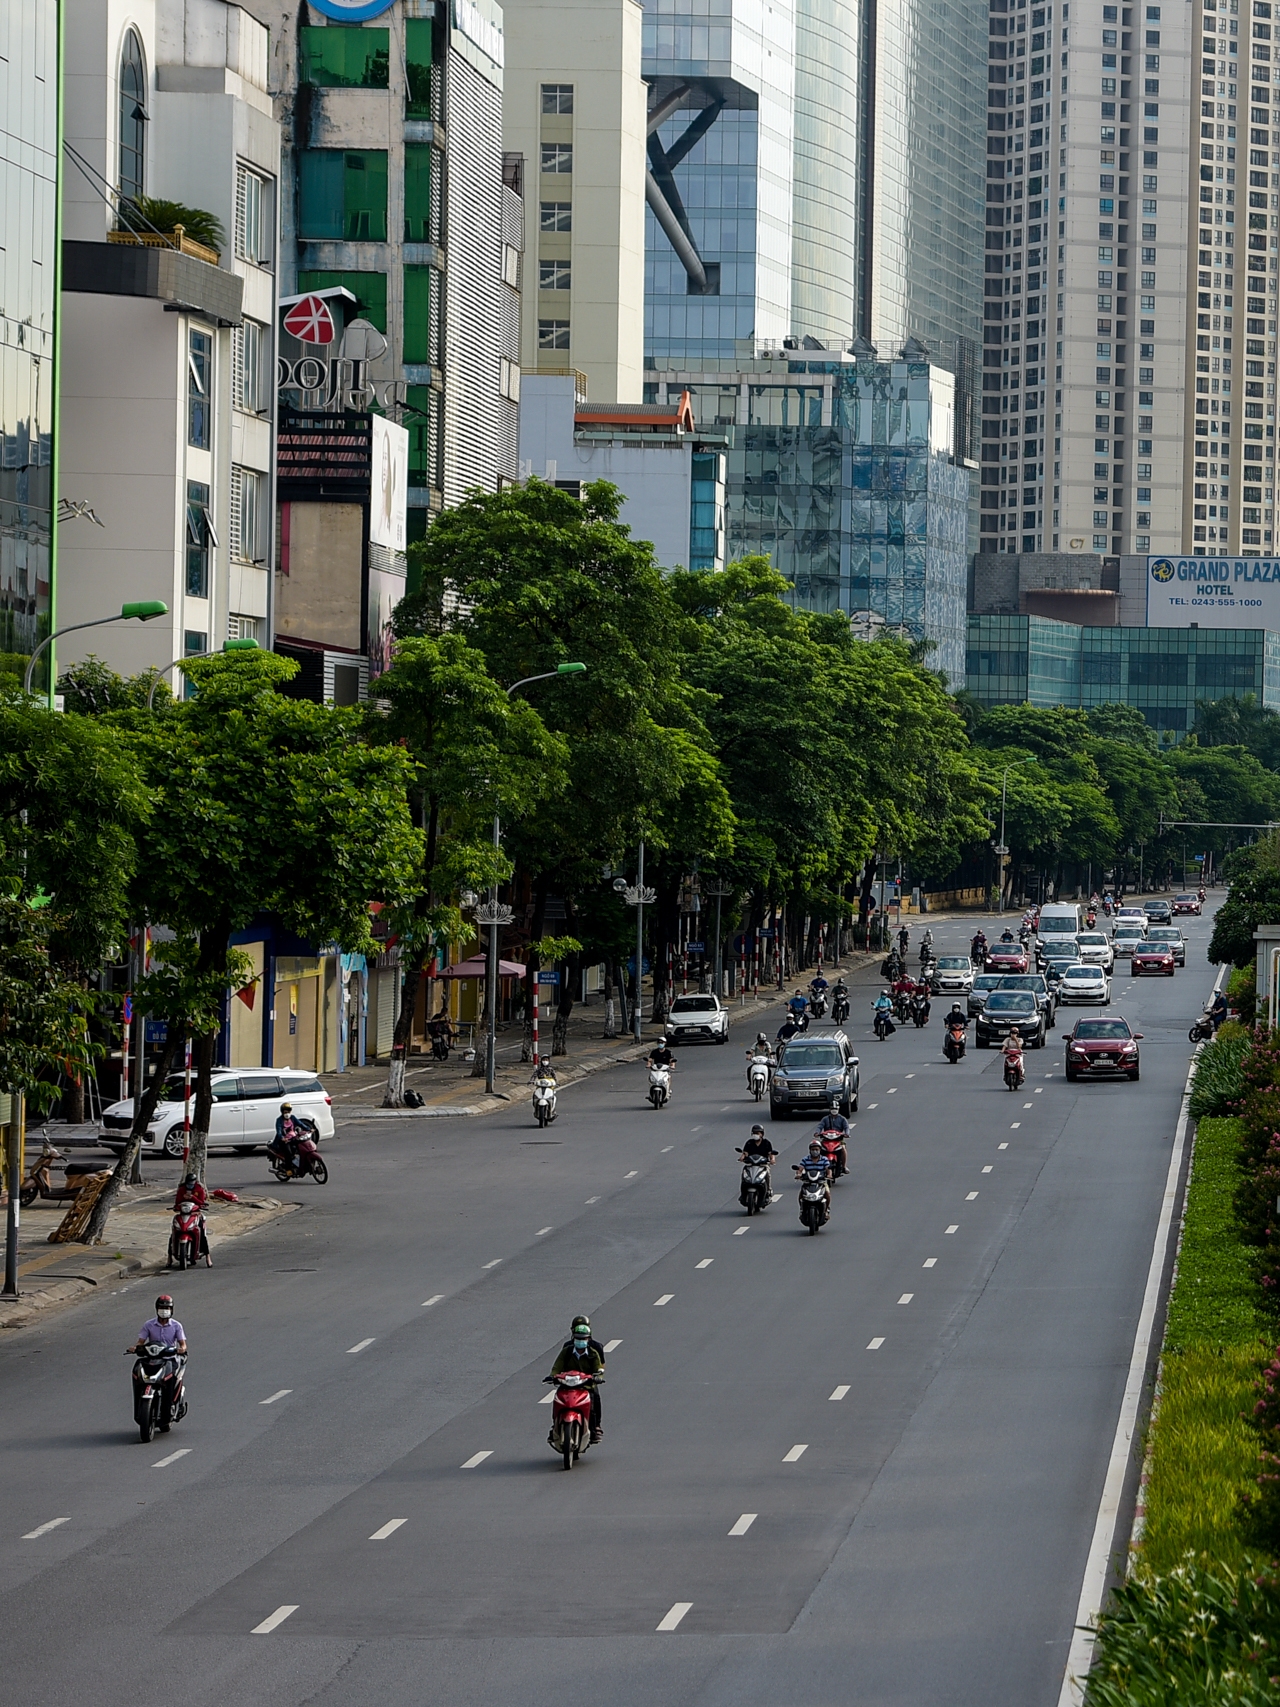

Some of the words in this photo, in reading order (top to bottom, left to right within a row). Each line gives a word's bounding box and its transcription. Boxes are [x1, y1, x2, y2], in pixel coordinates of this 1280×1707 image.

[1069, 538, 1086, 549] C7
[1176, 560, 1230, 582] GRAND
[1196, 584, 1234, 596] HOTEL
[1169, 598, 1189, 606] TEL:
[1191, 598, 1262, 607] 0243-555-1000
